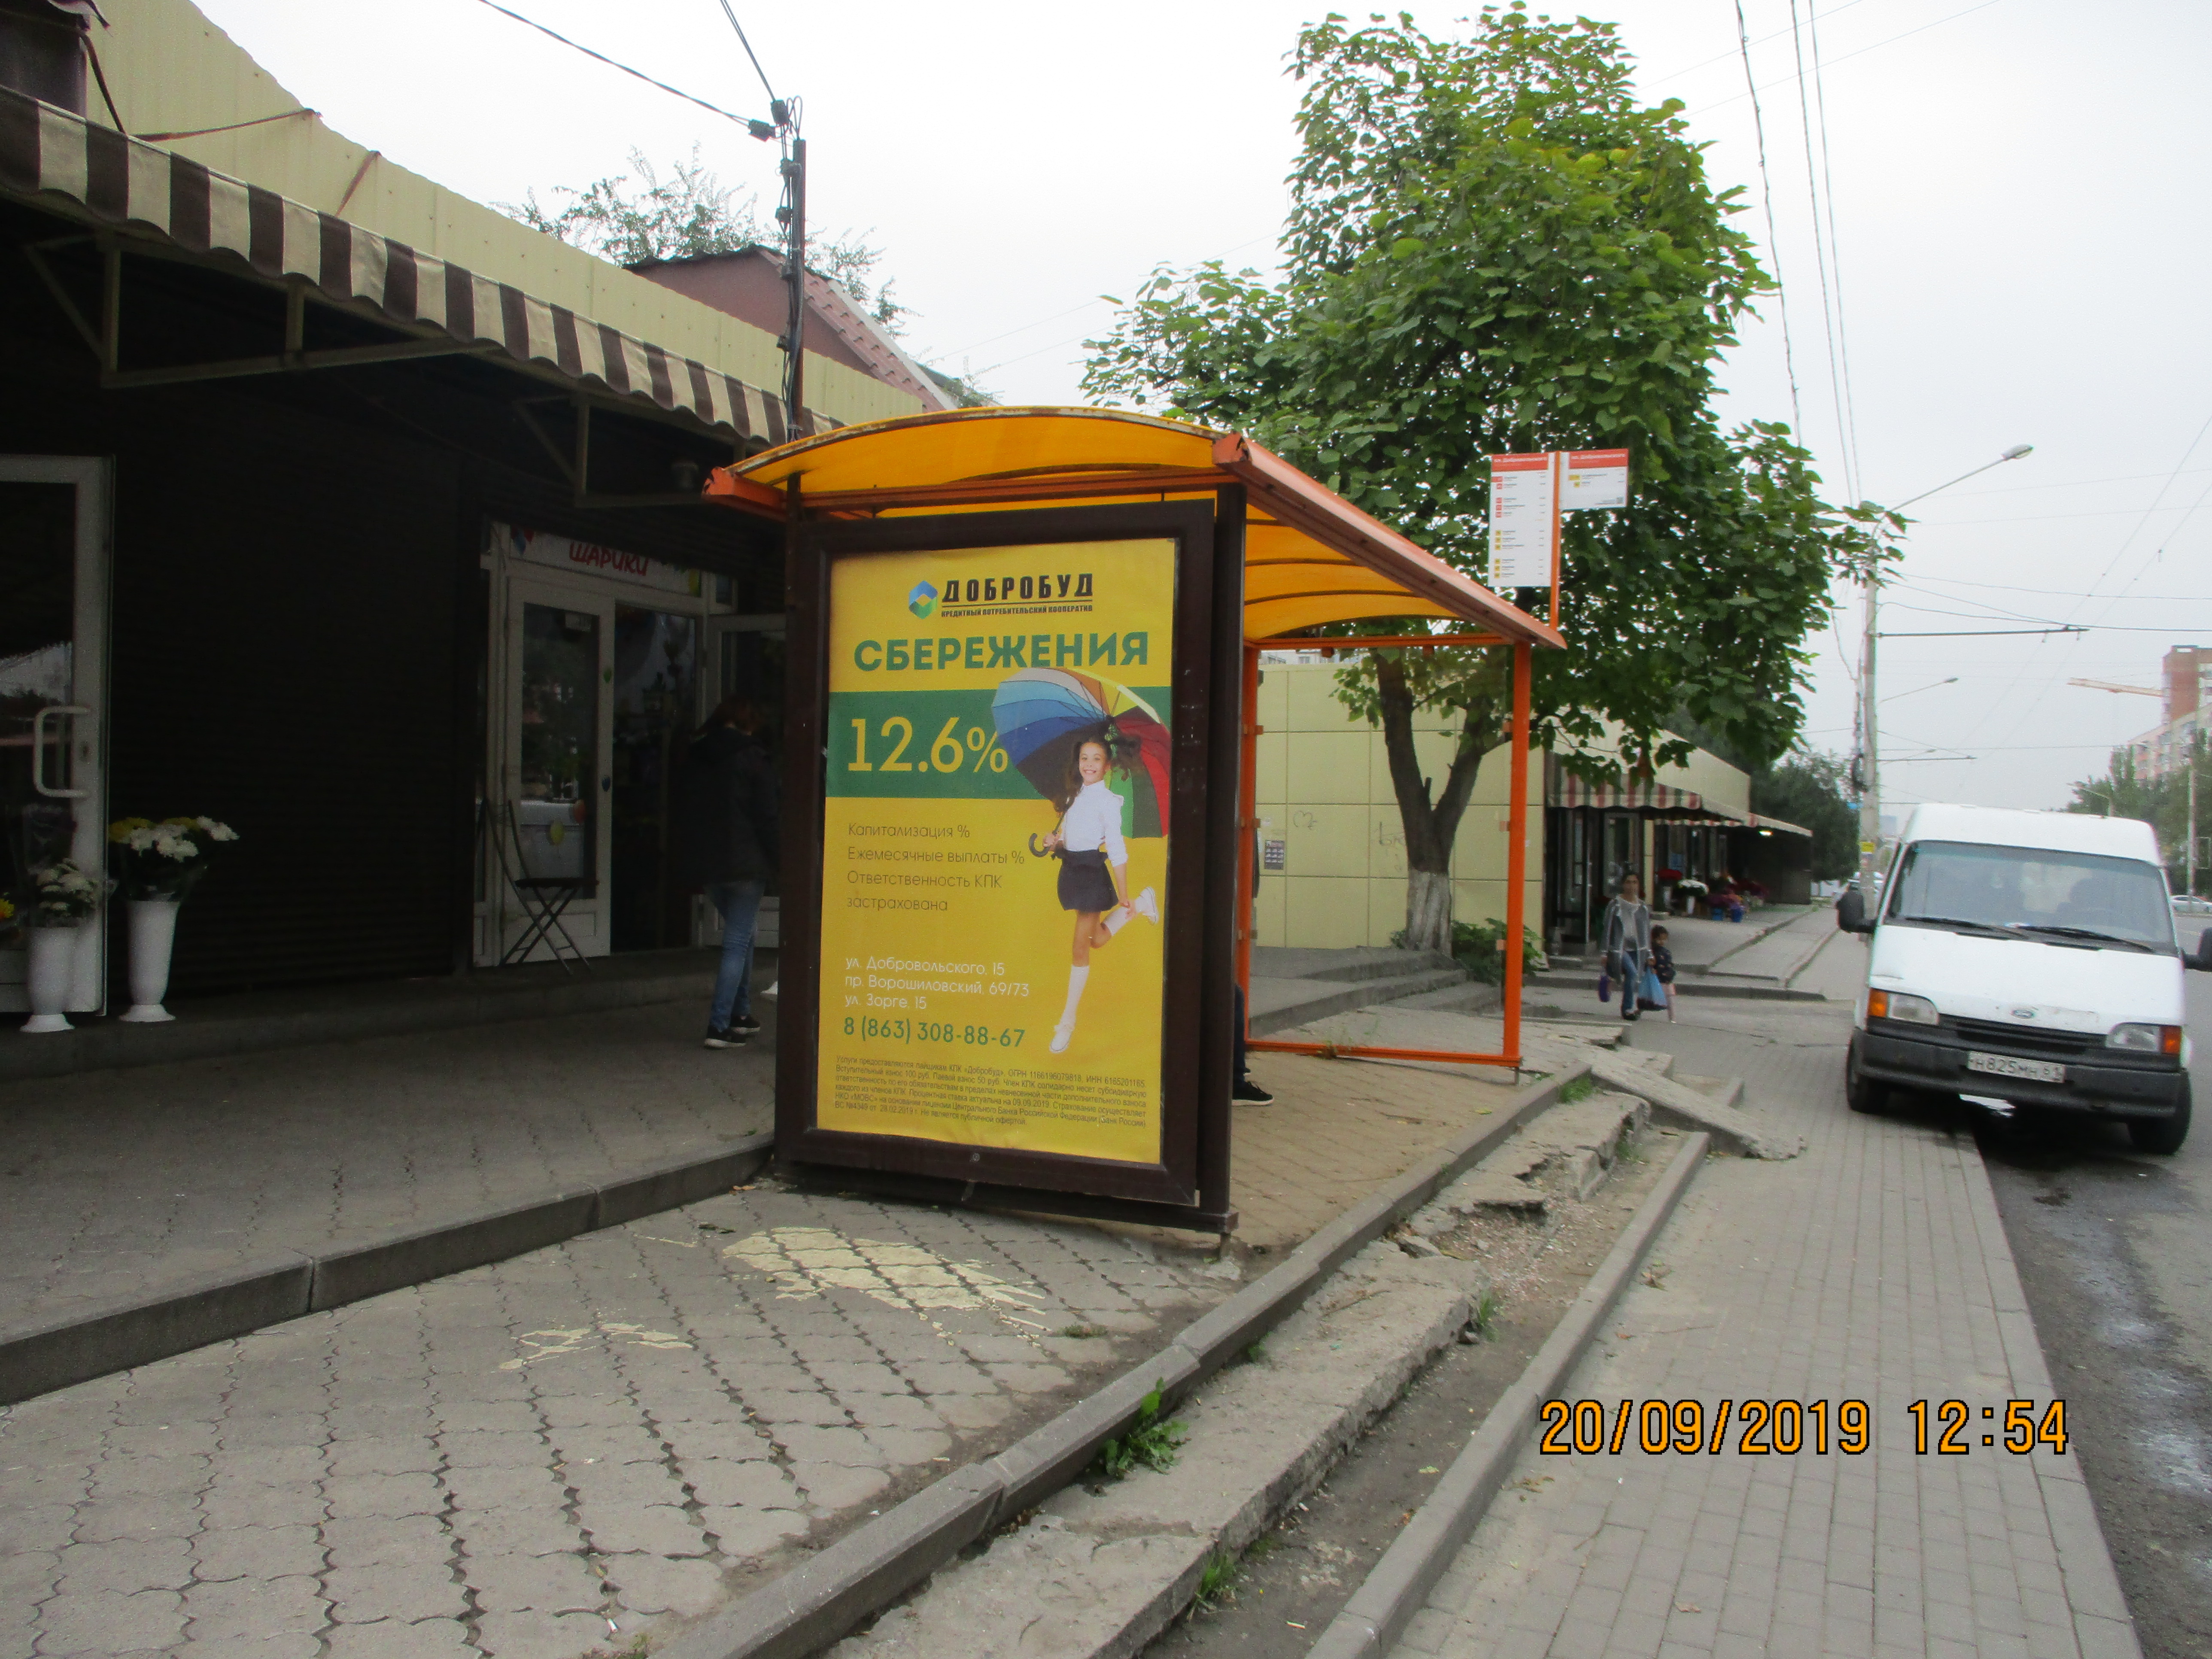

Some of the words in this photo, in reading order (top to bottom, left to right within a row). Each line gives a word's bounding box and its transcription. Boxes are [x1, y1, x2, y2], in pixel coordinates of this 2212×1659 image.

[942, 574, 1093, 602] ДОБРОБУД
[942, 609, 981, 617] КРЕДИТНЫЙ
[982, 606, 1047, 616] ПОТРЕБИТЕЛЬСКИЙ
[1049, 605, 1093, 613] КООПЕРАТИВ
[854, 632, 1149, 672] СБЕРЕЖЕНИЯ
[848, 717, 1008, 773] 12.6%
[848, 823, 953, 839] Капитализация
[957, 825, 970, 838] %
[848, 847, 943, 862] Ежемесячные
[948, 851, 1008, 864] выплаты
[1012, 851, 1025, 864] %
[847, 871, 970, 888] Ответственность
[975, 875, 1002, 889] КПК
[847, 896, 948, 913] застрахована
[845, 958, 862, 970] ул.
[866, 956, 987, 975] Добровольского,
[993, 963, 1005, 975] 15
[845, 975, 864, 988] пр.
[868, 975, 984, 995] Ворошиловский,
[989, 982, 1030, 997] 69/73
[845, 994, 861, 1007] ул.
[866, 993, 910, 1009] Зорге,
[915, 997, 927, 1009] 15
[843, 1017, 854, 1035] 8
[861, 1015, 911, 1043] (863)
[917, 1021, 1025, 1048] 308-88-67
[836, 1056, 857, 1064] Услуги
[859, 1058, 914, 1069] предоставляются
[1008, 1069, 1027, 1077] ОГРН
[836, 1065, 883, 1075] Вступительный
[933, 1073, 955, 1082] Паевой
[1037, 1082, 1074, 1092] солидарно
[1098, 1087, 1146, 1098] субсидиарную
[836, 1075, 887, 1085] ответственность
[909, 1080, 958, 1091] обязательствам
[965, 1086, 996, 1095] пределах
[998, 1089, 1040, 1098] невнесенной
[1063, 1094, 1121, 1106] дополнительного
[1123, 1099, 1146, 1108] взноса
[909, 1089, 946, 1099] Процентная
[948, 1093, 967, 1101] ставка
[969, 1095, 1001, 1105] актуальна
[1053, 1101, 1096, 1113] Страхование
[1098, 1107, 1146, 1118] осуществляет
[952, 1102, 995, 1115] Центрального
[998, 1107, 1017, 1115] Банка
[1020, 1109, 1058, 1119] Российской
[931, 1110, 958, 1119] является
[960, 1112, 994, 1123] публичной
